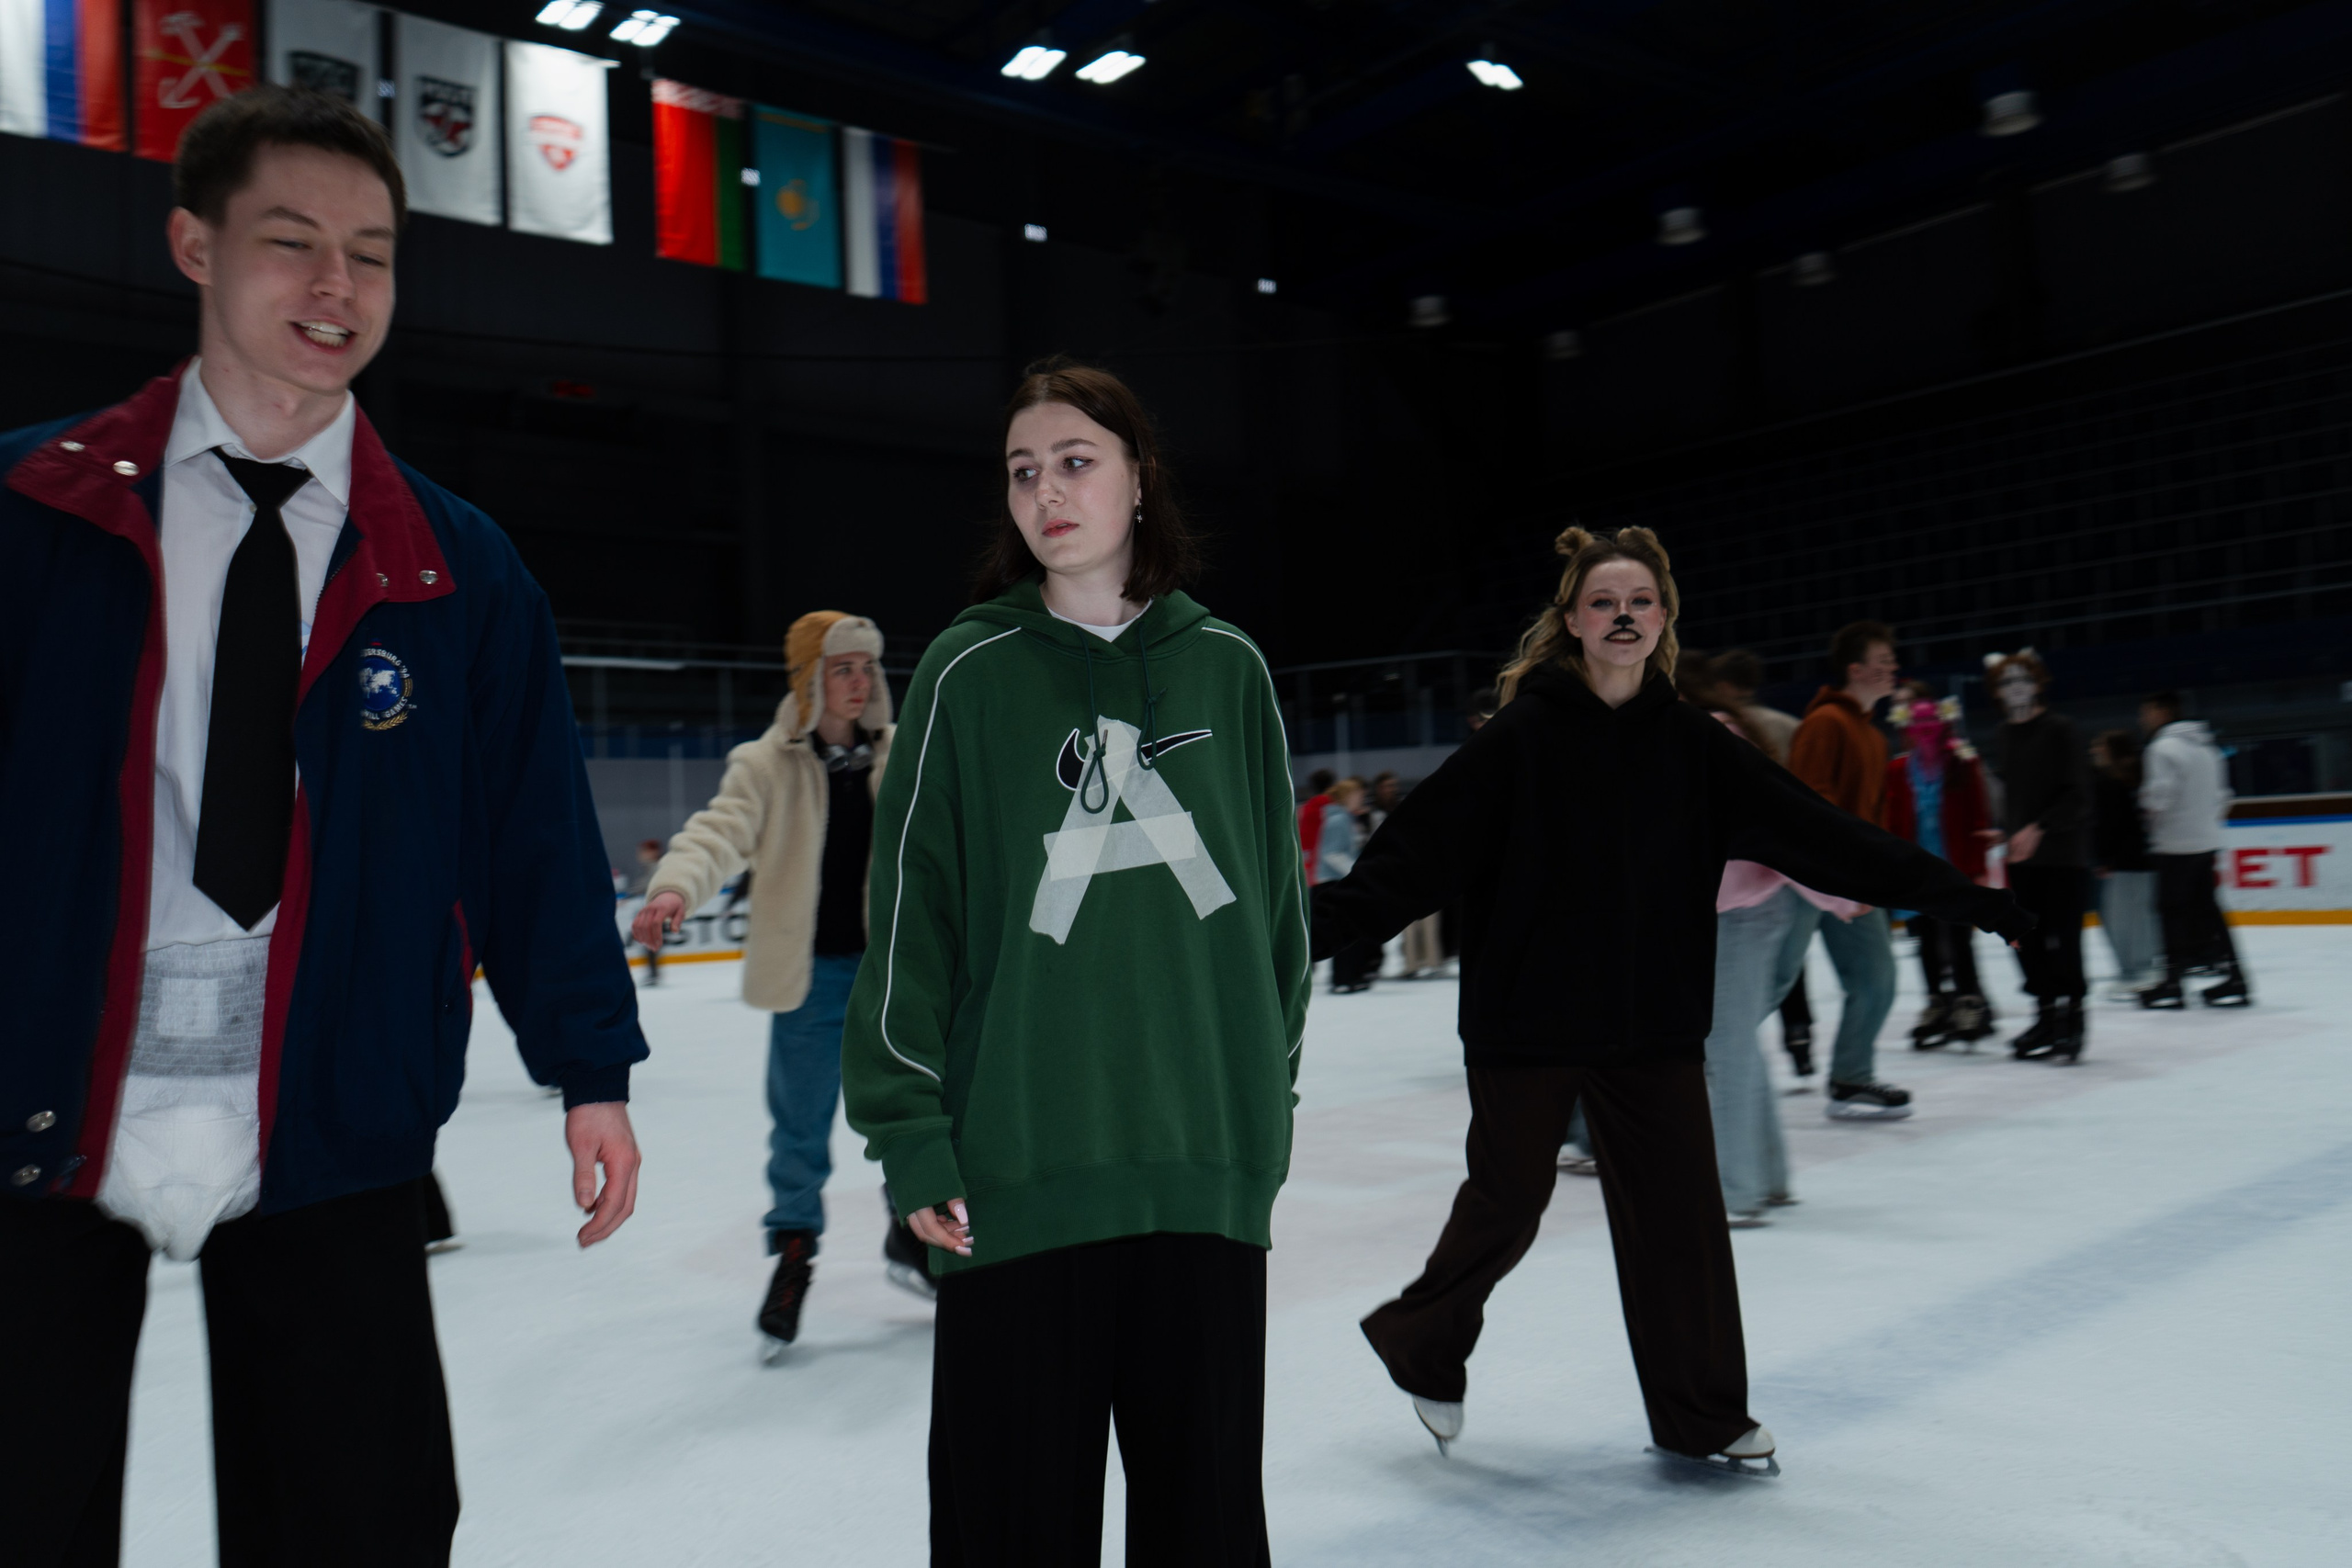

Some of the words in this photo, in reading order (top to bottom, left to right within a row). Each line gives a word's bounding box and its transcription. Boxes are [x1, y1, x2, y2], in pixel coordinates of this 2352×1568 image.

[360, 649, 402, 666] ERSBURG
[384, 696, 408, 717] GAMES
[2212, 846, 2331, 888] ET
